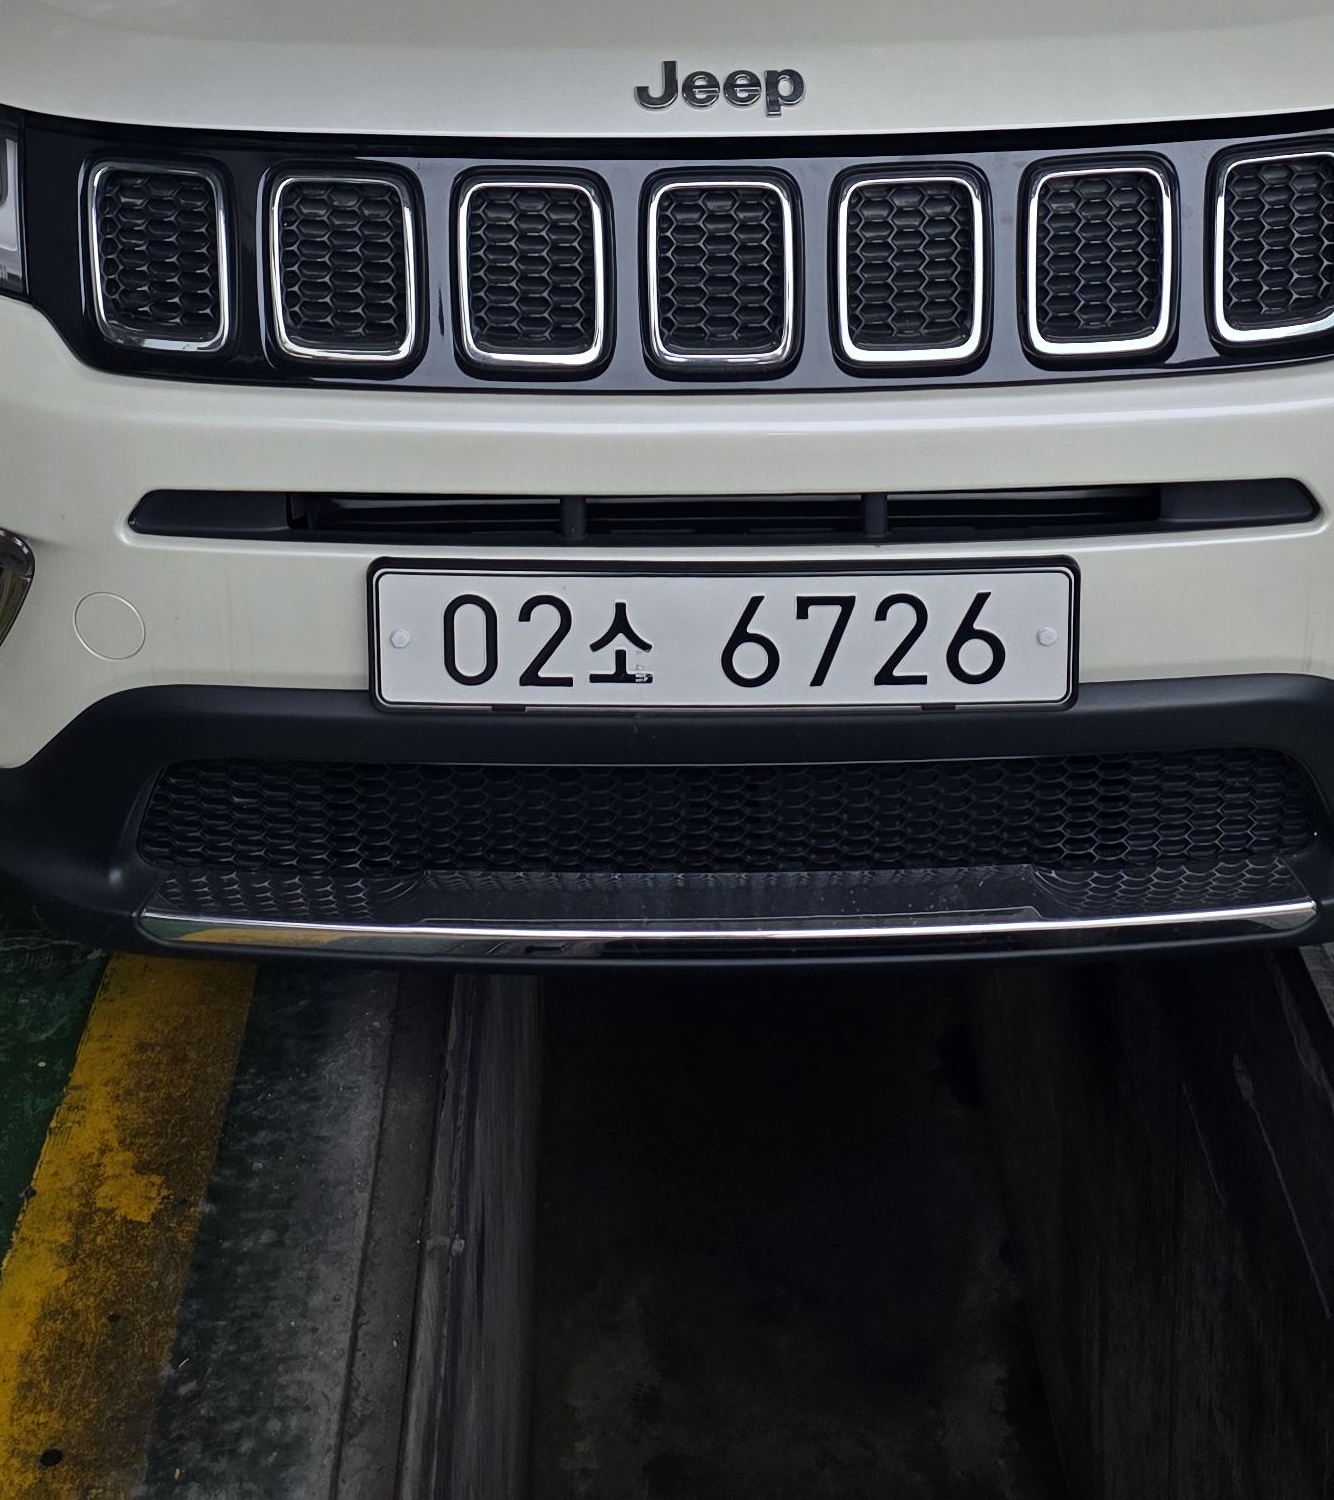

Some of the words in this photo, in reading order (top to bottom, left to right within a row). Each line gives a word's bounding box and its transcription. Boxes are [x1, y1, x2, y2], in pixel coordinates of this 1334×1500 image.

[634, 60, 806, 117] Jeep
[442, 593, 655, 689] 02소
[720, 591, 1006, 689] 6726
